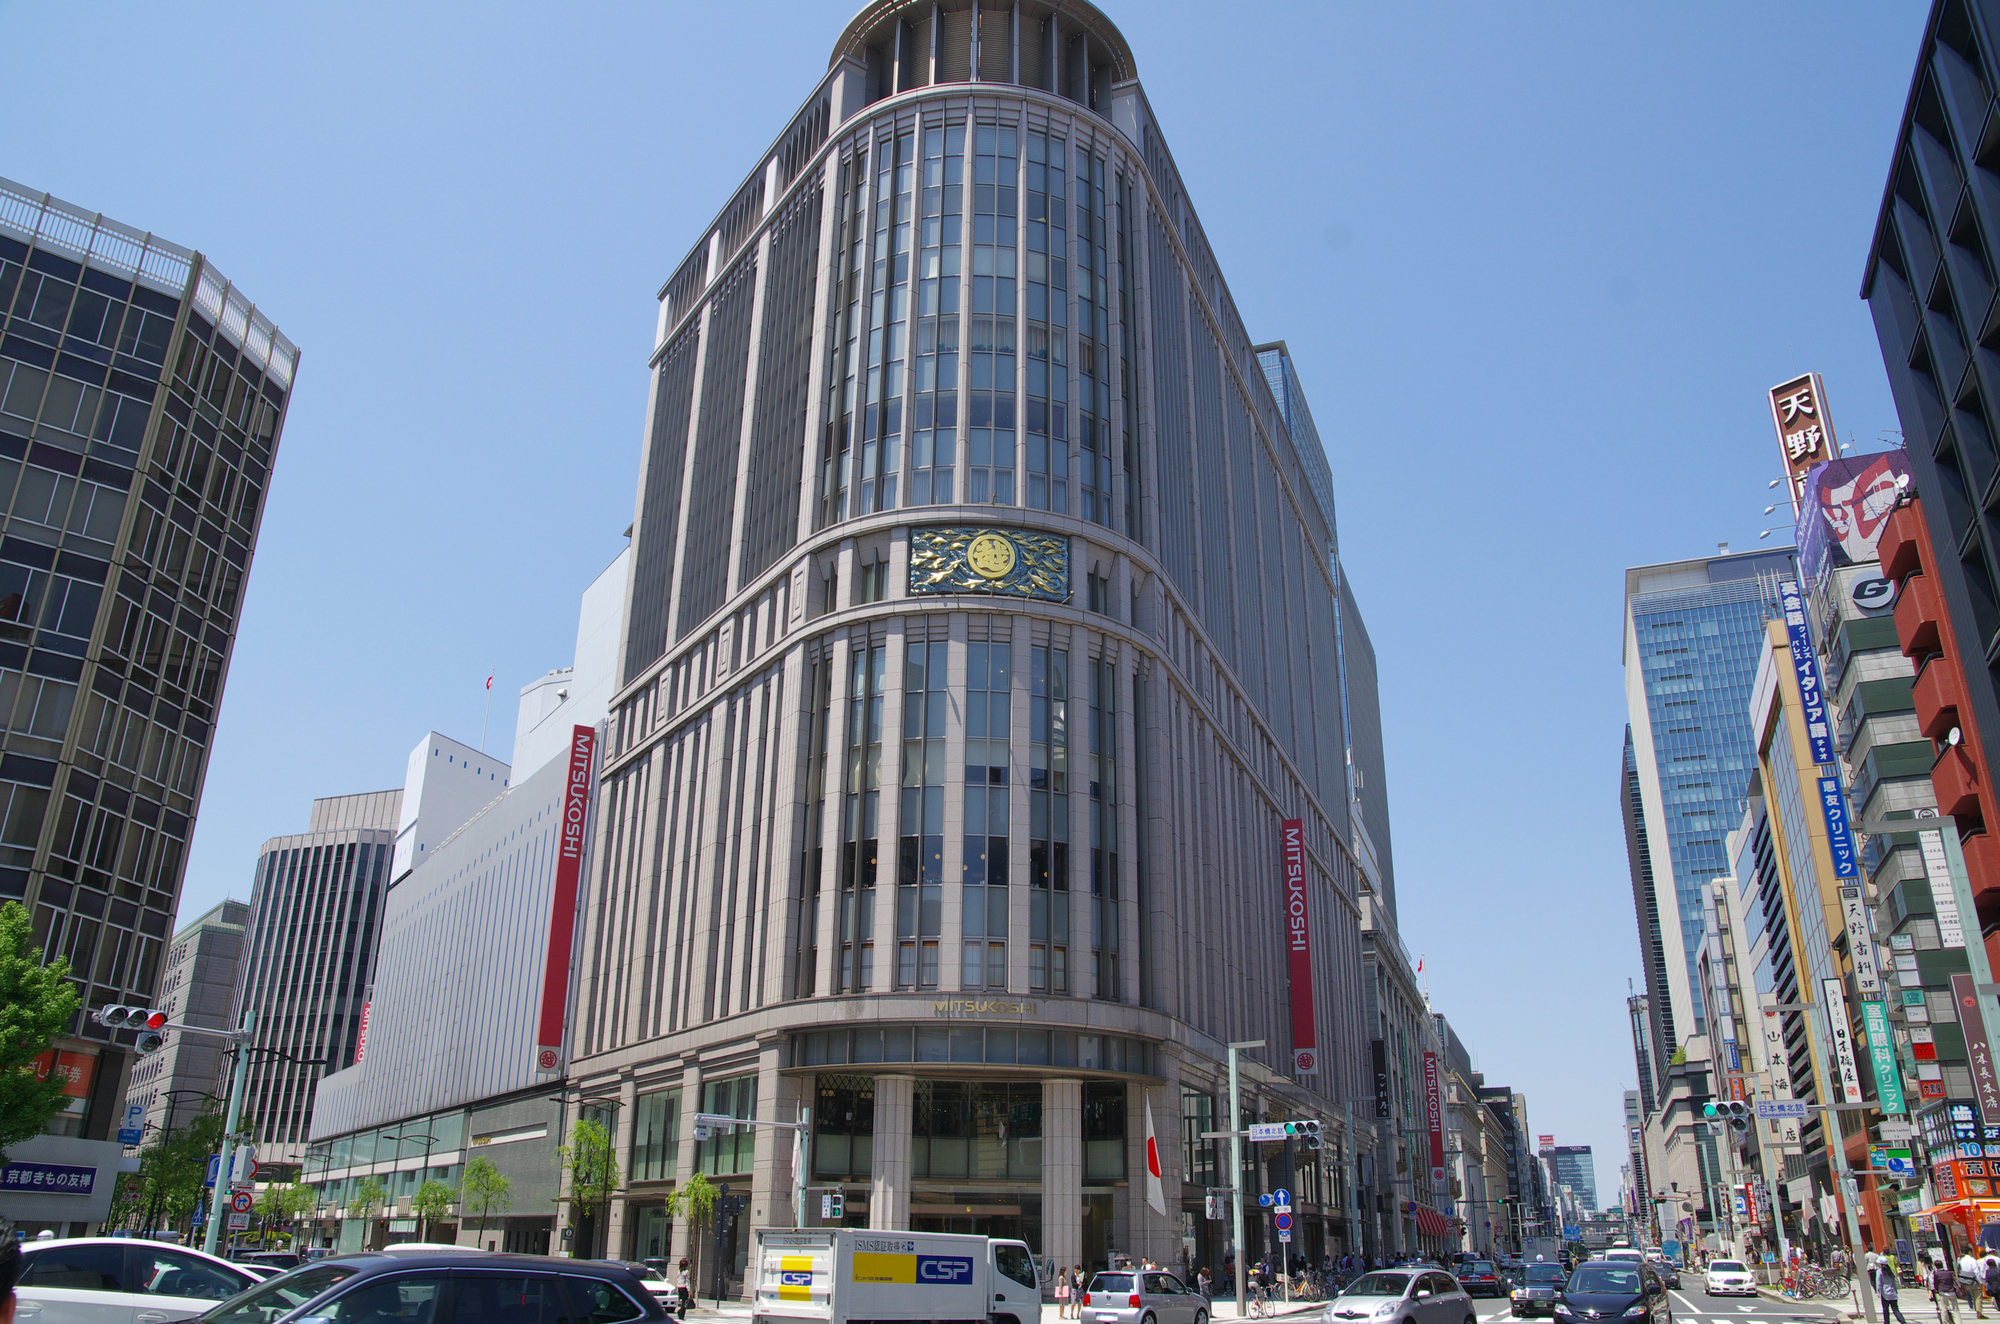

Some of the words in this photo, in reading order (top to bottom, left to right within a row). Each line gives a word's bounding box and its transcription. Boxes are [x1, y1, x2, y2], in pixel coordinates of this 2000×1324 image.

[1780, 581, 1804, 626] 英会話
[1798, 661, 1828, 739] イタリア語
[563, 734, 591, 858] MITSUKOSHI
[1822, 781, 1852, 874] 恵友クリニック
[1285, 828, 1306, 951] MITSUKOSHI
[1861, 980, 1875, 988] 3F
[933, 1000, 1037, 1015] MITSUKOSHI
[358, 1007, 370, 1063] MITSUKO
[1866, 1004, 1898, 1111] 室町眼科クリニック
[1426, 1057, 1440, 1132] MITSUKOSHI
[128, 1106, 143, 1119] P
[1759, 1104, 1805, 1113] 日本橋北詰
[1984, 1129, 1999, 1138] 2F
[1959, 1143, 1981, 1156] 10
[6, 1169, 92, 1188] 京都きもの友禅
[854, 1240, 900, 1252] ISMS認証取得
[782, 1272, 811, 1285] CSP
[920, 1260, 969, 1280] CSP
